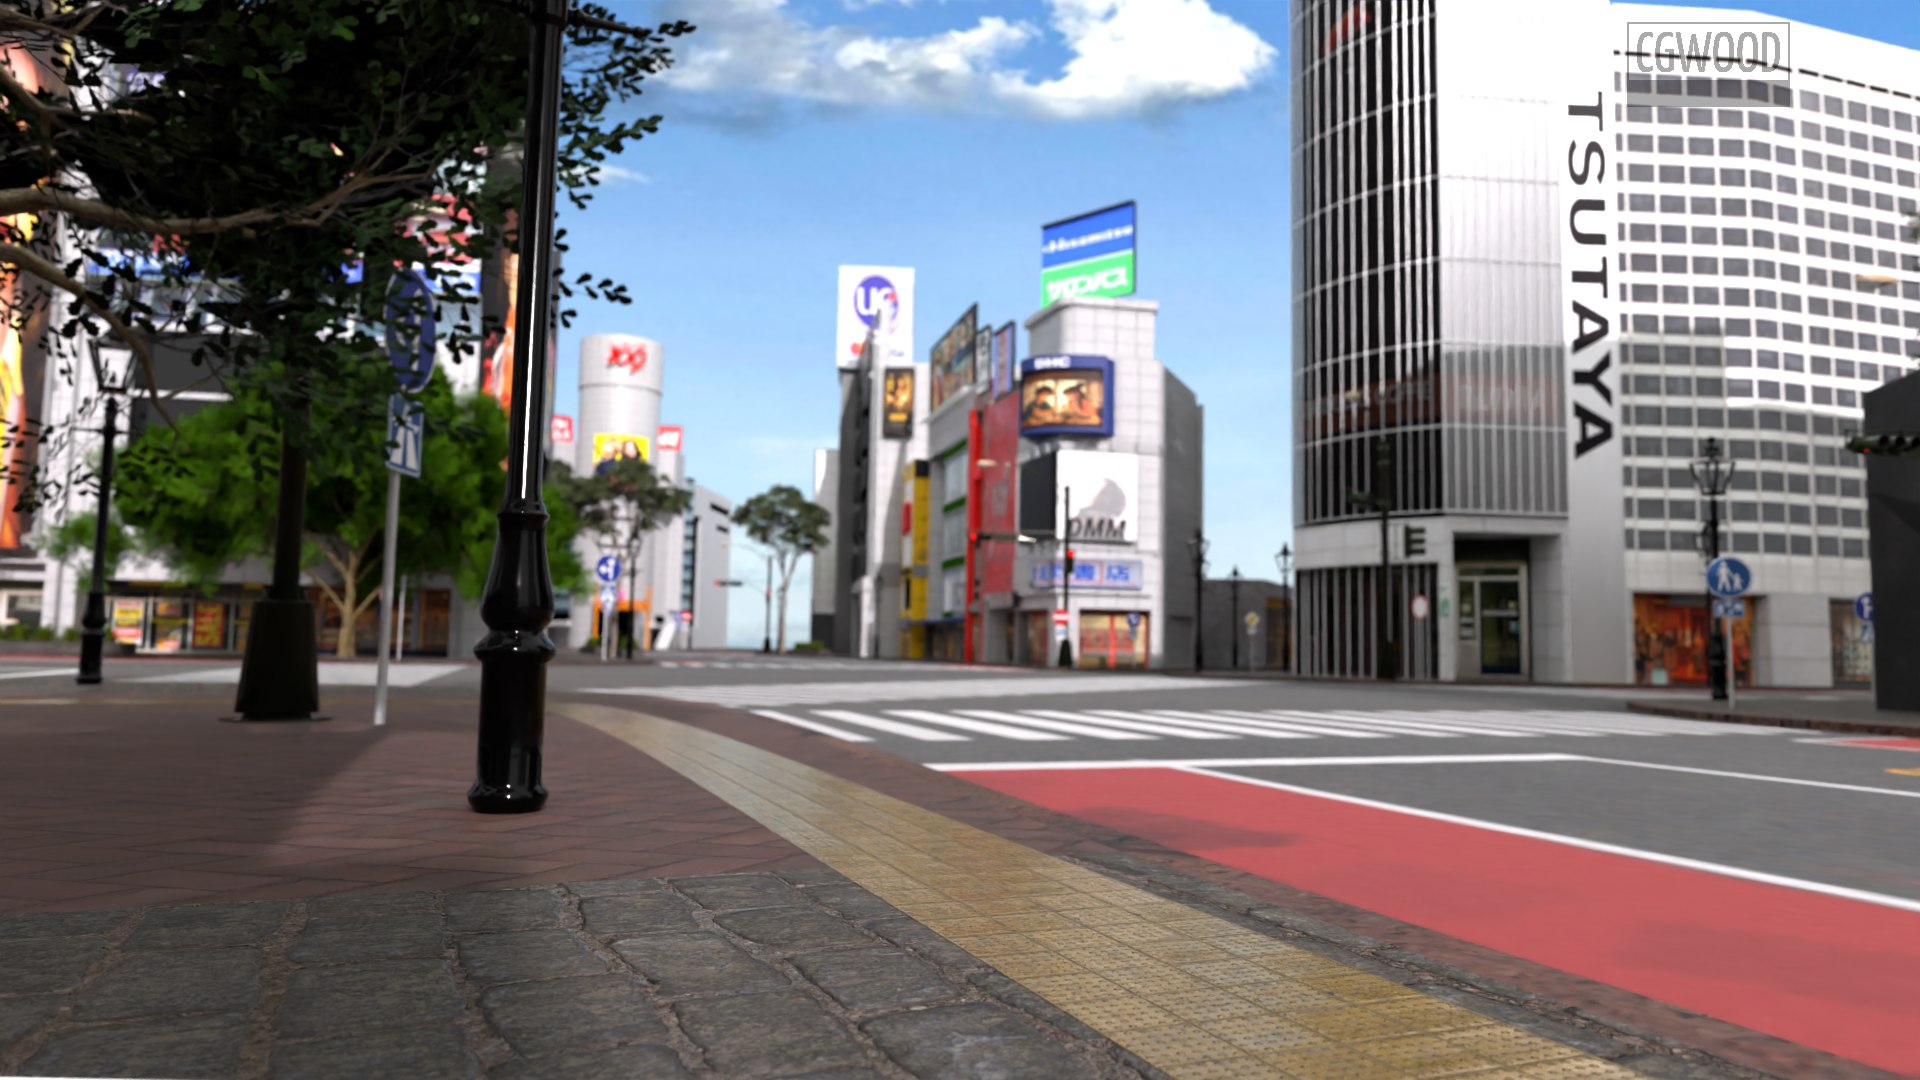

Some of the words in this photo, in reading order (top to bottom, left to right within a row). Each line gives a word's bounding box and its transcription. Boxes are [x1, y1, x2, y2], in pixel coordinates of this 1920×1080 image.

[1568, 91, 1614, 459] TSUTAYA
[606, 343, 648, 375] 109
[1068, 518, 1126, 538] DMM
